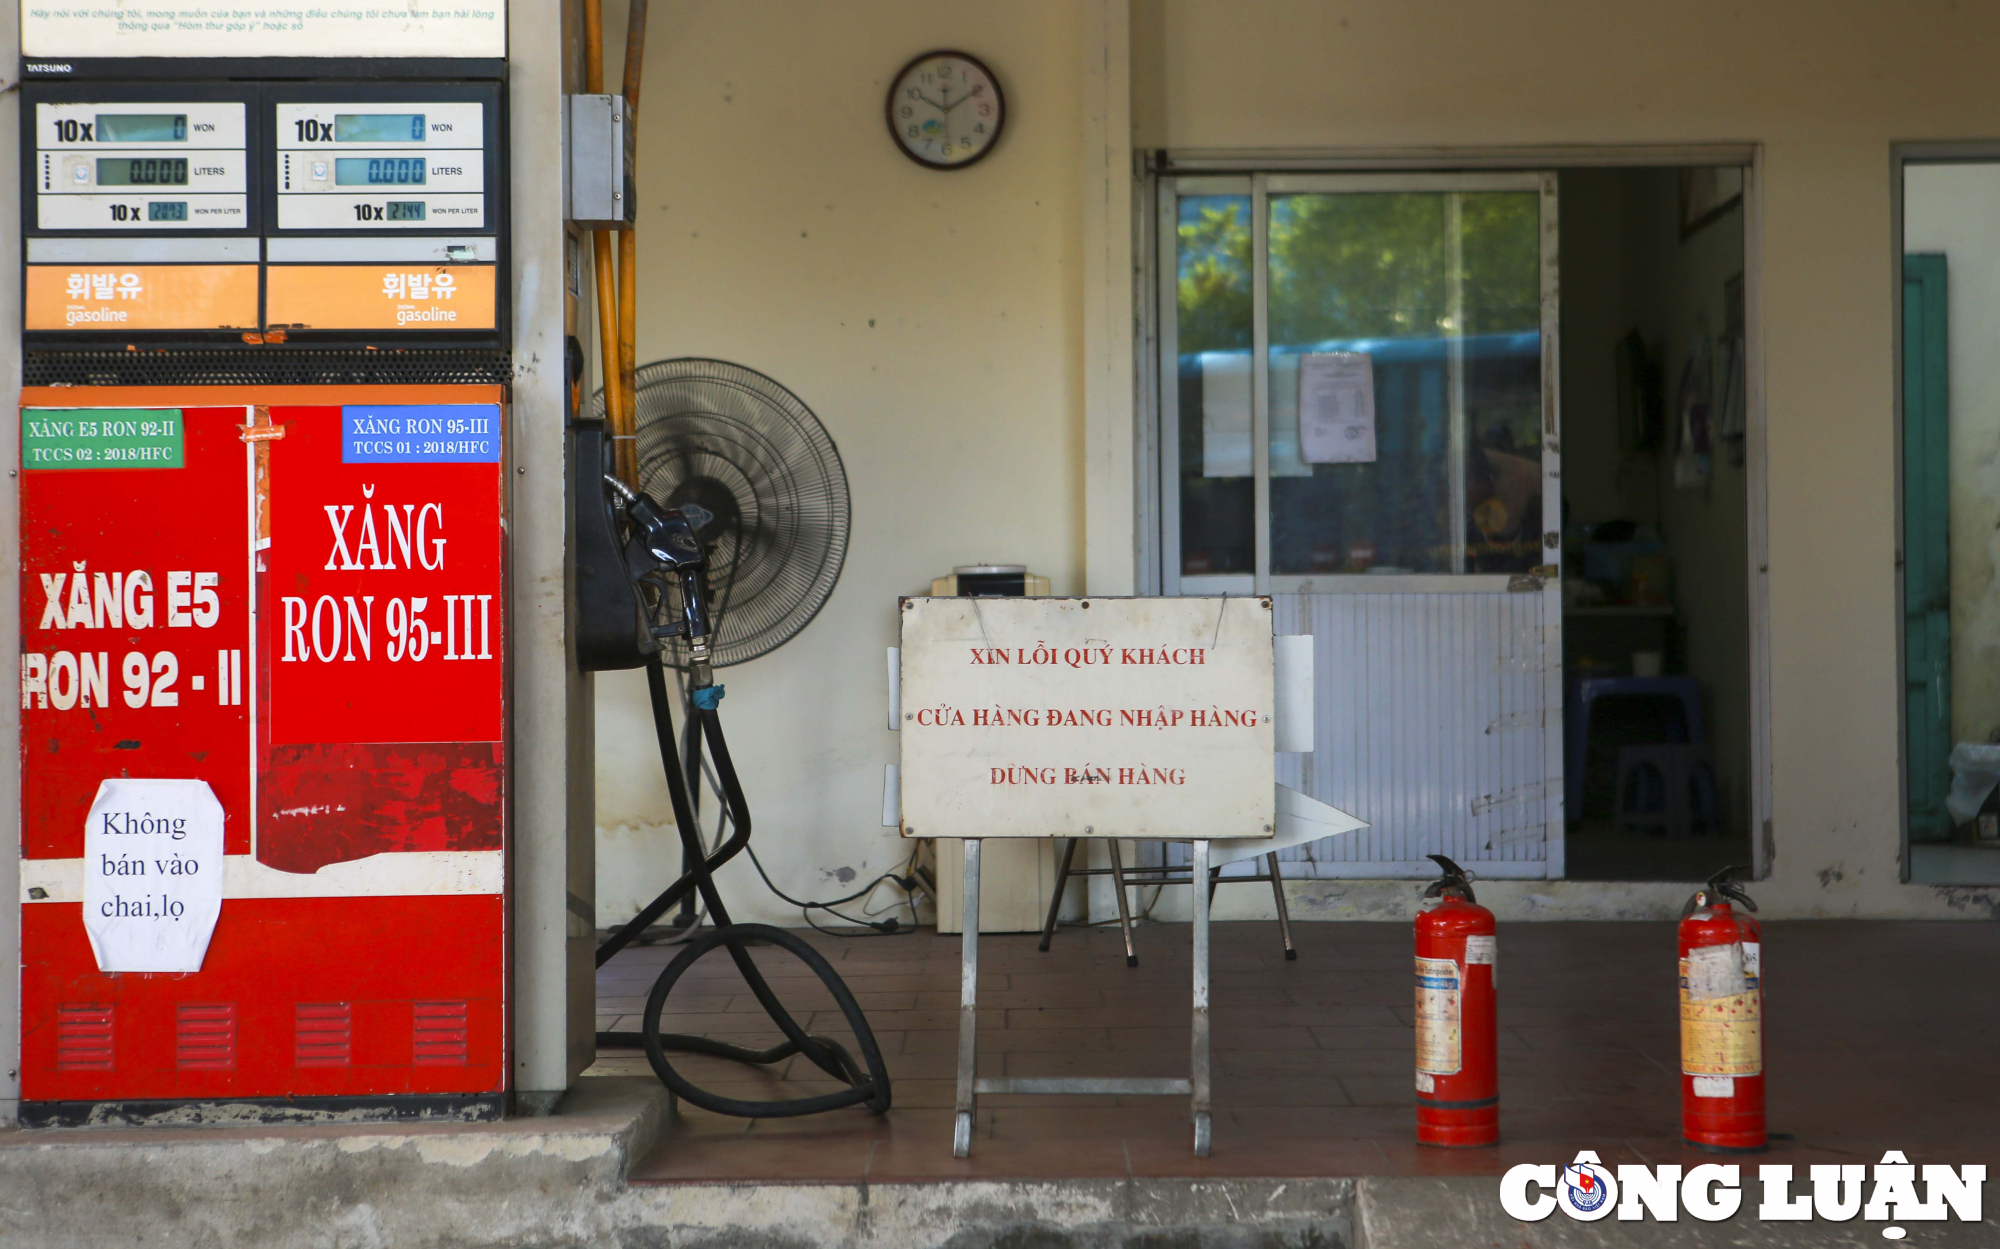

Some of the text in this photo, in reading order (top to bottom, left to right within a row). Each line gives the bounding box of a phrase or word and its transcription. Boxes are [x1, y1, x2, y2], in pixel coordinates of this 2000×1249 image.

[53, 8, 69, 18] nói
[92, 8, 124, 20] chúng
[146, 10, 175, 20] mong
[232, 9, 251, 20] bạn
[254, 9, 266, 18] và
[269, 9, 303, 21] những
[331, 9, 362, 20] chúng
[365, 10, 379, 19] tôi
[432, 10, 451, 20] bạn
[472, 10, 495, 20] lòng
[118, 21, 148, 32] thông
[151, 23, 170, 32] qua
[26, 64, 72, 73] TATSUNO
[937, 66, 952, 79] 12
[901, 106, 912, 119] 9
[978, 103, 990, 117] 3
[173, 116, 185, 140] 0
[193, 123, 215, 132] WON
[411, 116, 424, 140] 0
[431, 123, 453, 132] WON
[908, 125, 919, 138] 8
[974, 123, 984, 135] 4
[924, 138, 933, 150] 7
[960, 137, 971, 150] 5
[130, 159, 187, 184] 0.000
[194, 167, 225, 176] LITERS
[368, 159, 424, 183] 0.000
[432, 167, 463, 176] LITERS
[392, 204, 421, 219] 2144
[66, 273, 143, 300] 휘발유
[382, 273, 458, 300] 휘발유
[66, 306, 128, 327] gasoline
[396, 305, 457, 326] gasoline
[28, 418, 175, 438] XĂNG E5 RON 92-II
[353, 414, 489, 435] XĂNG RON 95-III
[32, 447, 73, 462] TCCS
[76, 448, 93, 461] 02
[104, 447, 172, 461] 2018/HFC
[354, 440, 393, 454] TCCS
[396, 441, 411, 454] 01
[423, 440, 490, 454] 2018/HFC
[324, 483, 447, 571] XĂNG
[39, 560, 220, 631] XĂNG E5
[280, 594, 493, 663] RON 95-III
[970, 640, 1206, 669] XIN LỖI QUÝ KHÁCH
[20, 650, 109, 711] RON
[122, 649, 179, 709] 92
[917, 703, 1257, 731] CỬA HÀNG ĐANG NHẬP HÀNG
[990, 762, 1186, 786] DỪNG BÁN HÀNG
[101, 813, 187, 839] Không
[101, 853, 198, 876] bán vào
[101, 895, 184, 921] chai,lọ
